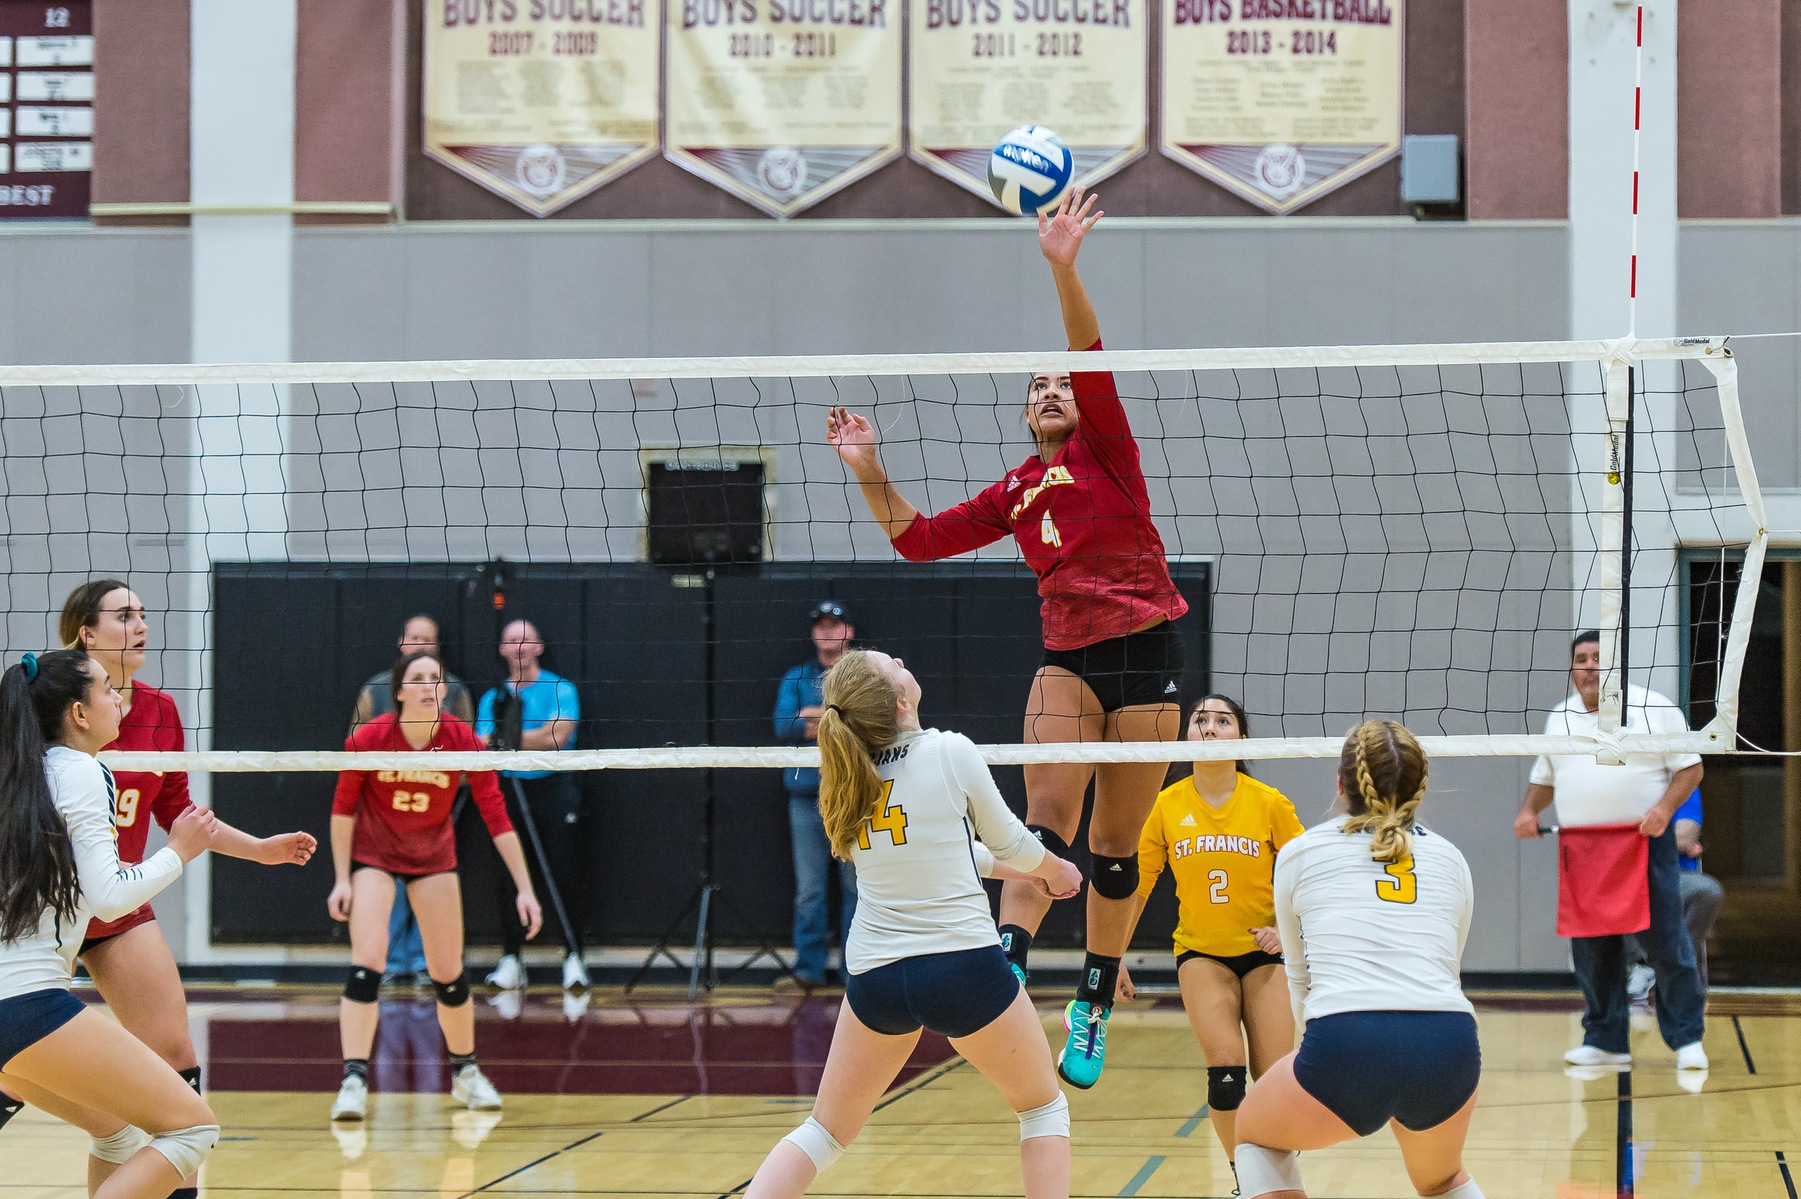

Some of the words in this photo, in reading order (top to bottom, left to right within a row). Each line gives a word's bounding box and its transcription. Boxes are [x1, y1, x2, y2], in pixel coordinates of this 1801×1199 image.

[44, 7, 71, 28] 12
[443, 0, 517, 28] BOYS
[529, 0, 646, 28] SOCCER
[683, 0, 758, 29] BOYS
[769, 0, 887, 28] SOCCER
[926, 0, 1000, 29] BOYS
[1014, 0, 1131, 28] SOCCER
[1174, 0, 1232, 25] BOYS
[1241, 0, 1393, 25] BASKETBALL
[972, 32, 1015, 57] 2011
[1037, 32, 1082, 57] 2012
[1226, 30, 1272, 55] 2013
[1291, 30, 1338, 55] 2014
[1041, 508, 1063, 549] 4
[392, 789, 430, 813] 23
[1174, 838, 1194, 861] ST.
[1195, 834, 1261, 859] FRANCIS
[1207, 868, 1231, 905] 2
[1371, 853, 1418, 905] 3
